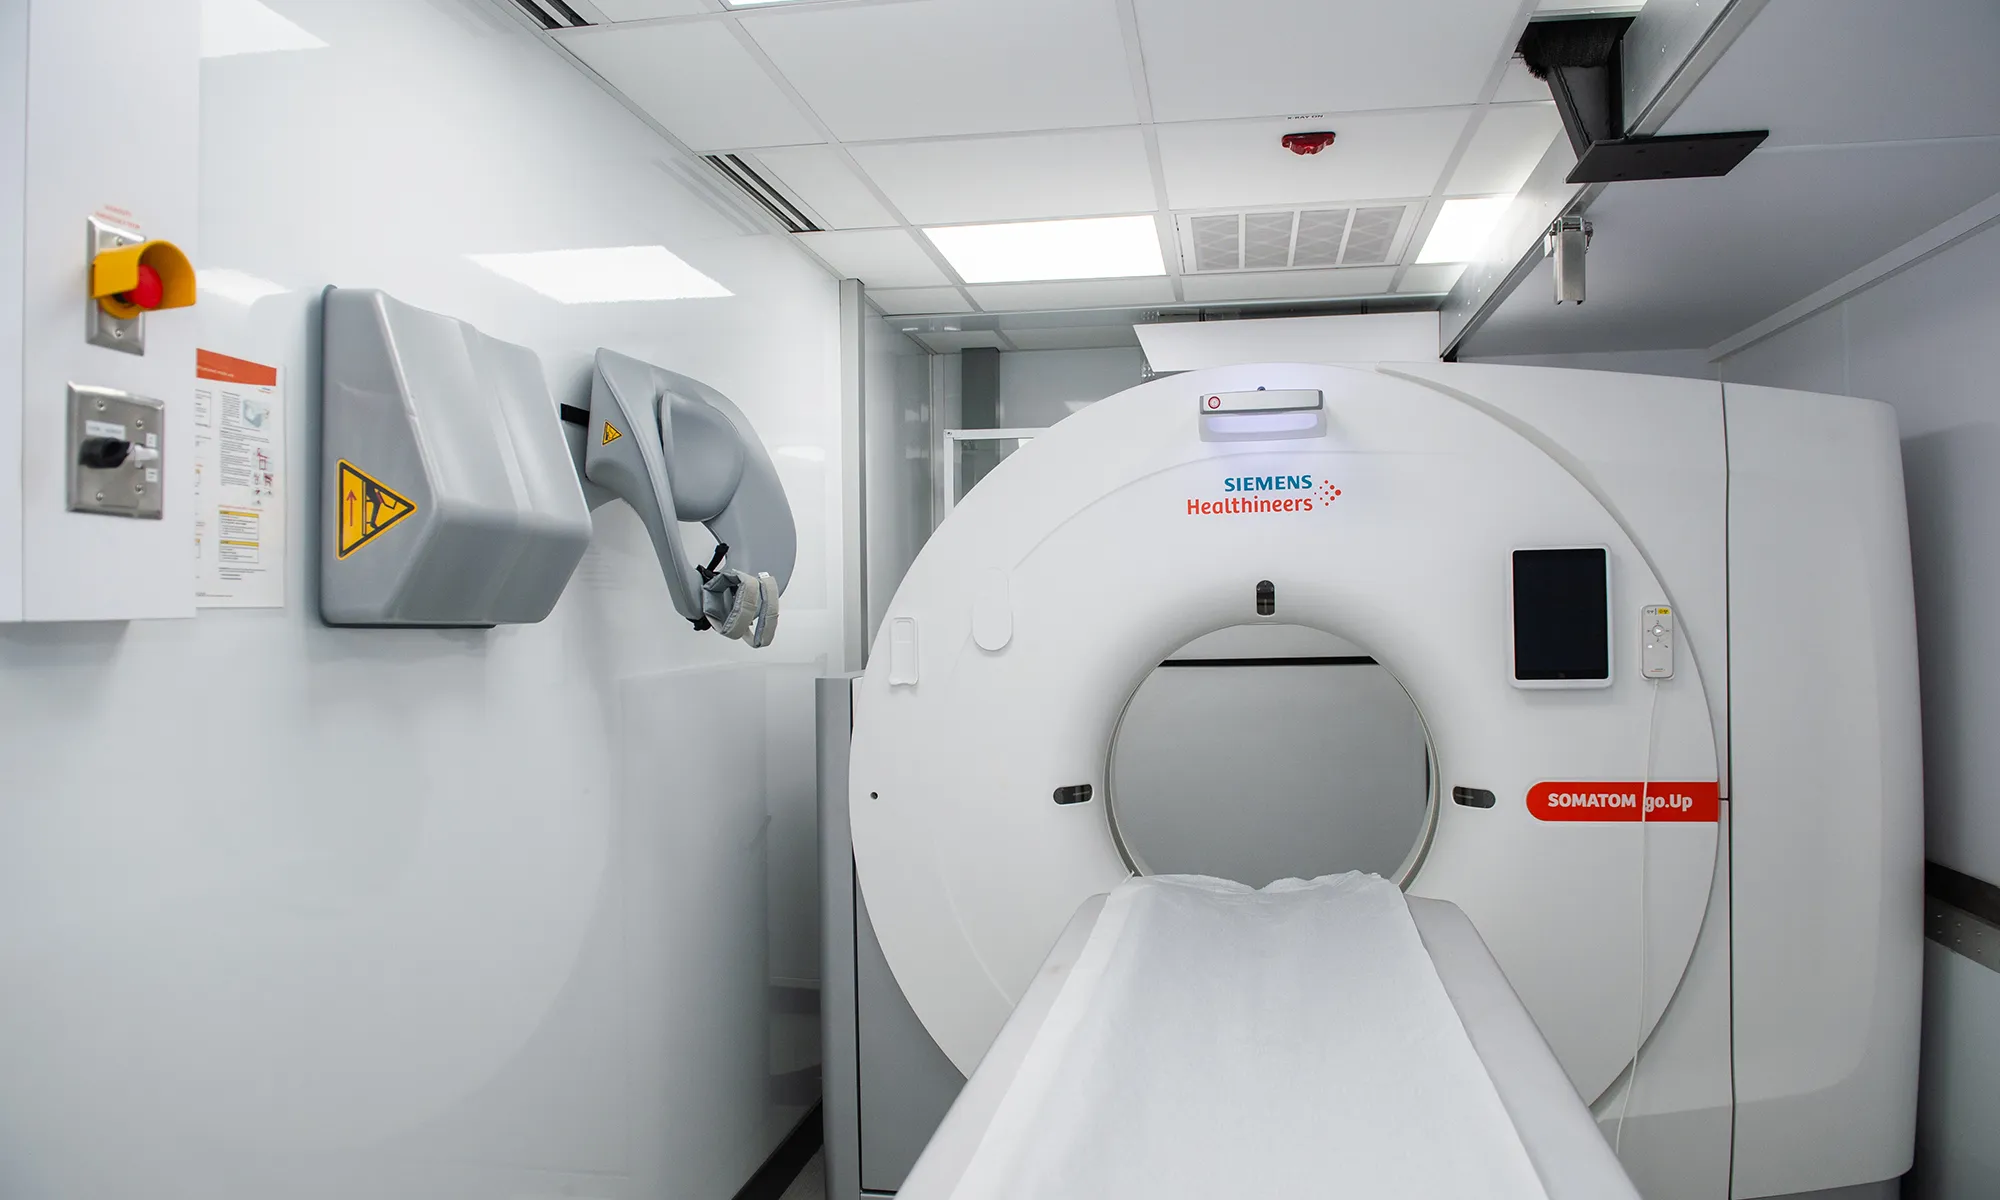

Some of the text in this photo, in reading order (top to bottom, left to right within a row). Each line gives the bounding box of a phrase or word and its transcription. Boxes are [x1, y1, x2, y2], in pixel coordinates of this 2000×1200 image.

[1224, 474, 1313, 492] SIEMENS
[1187, 495, 1313, 515] Healthineers
[1547, 793, 1693, 812] SOMATOM go.Up
